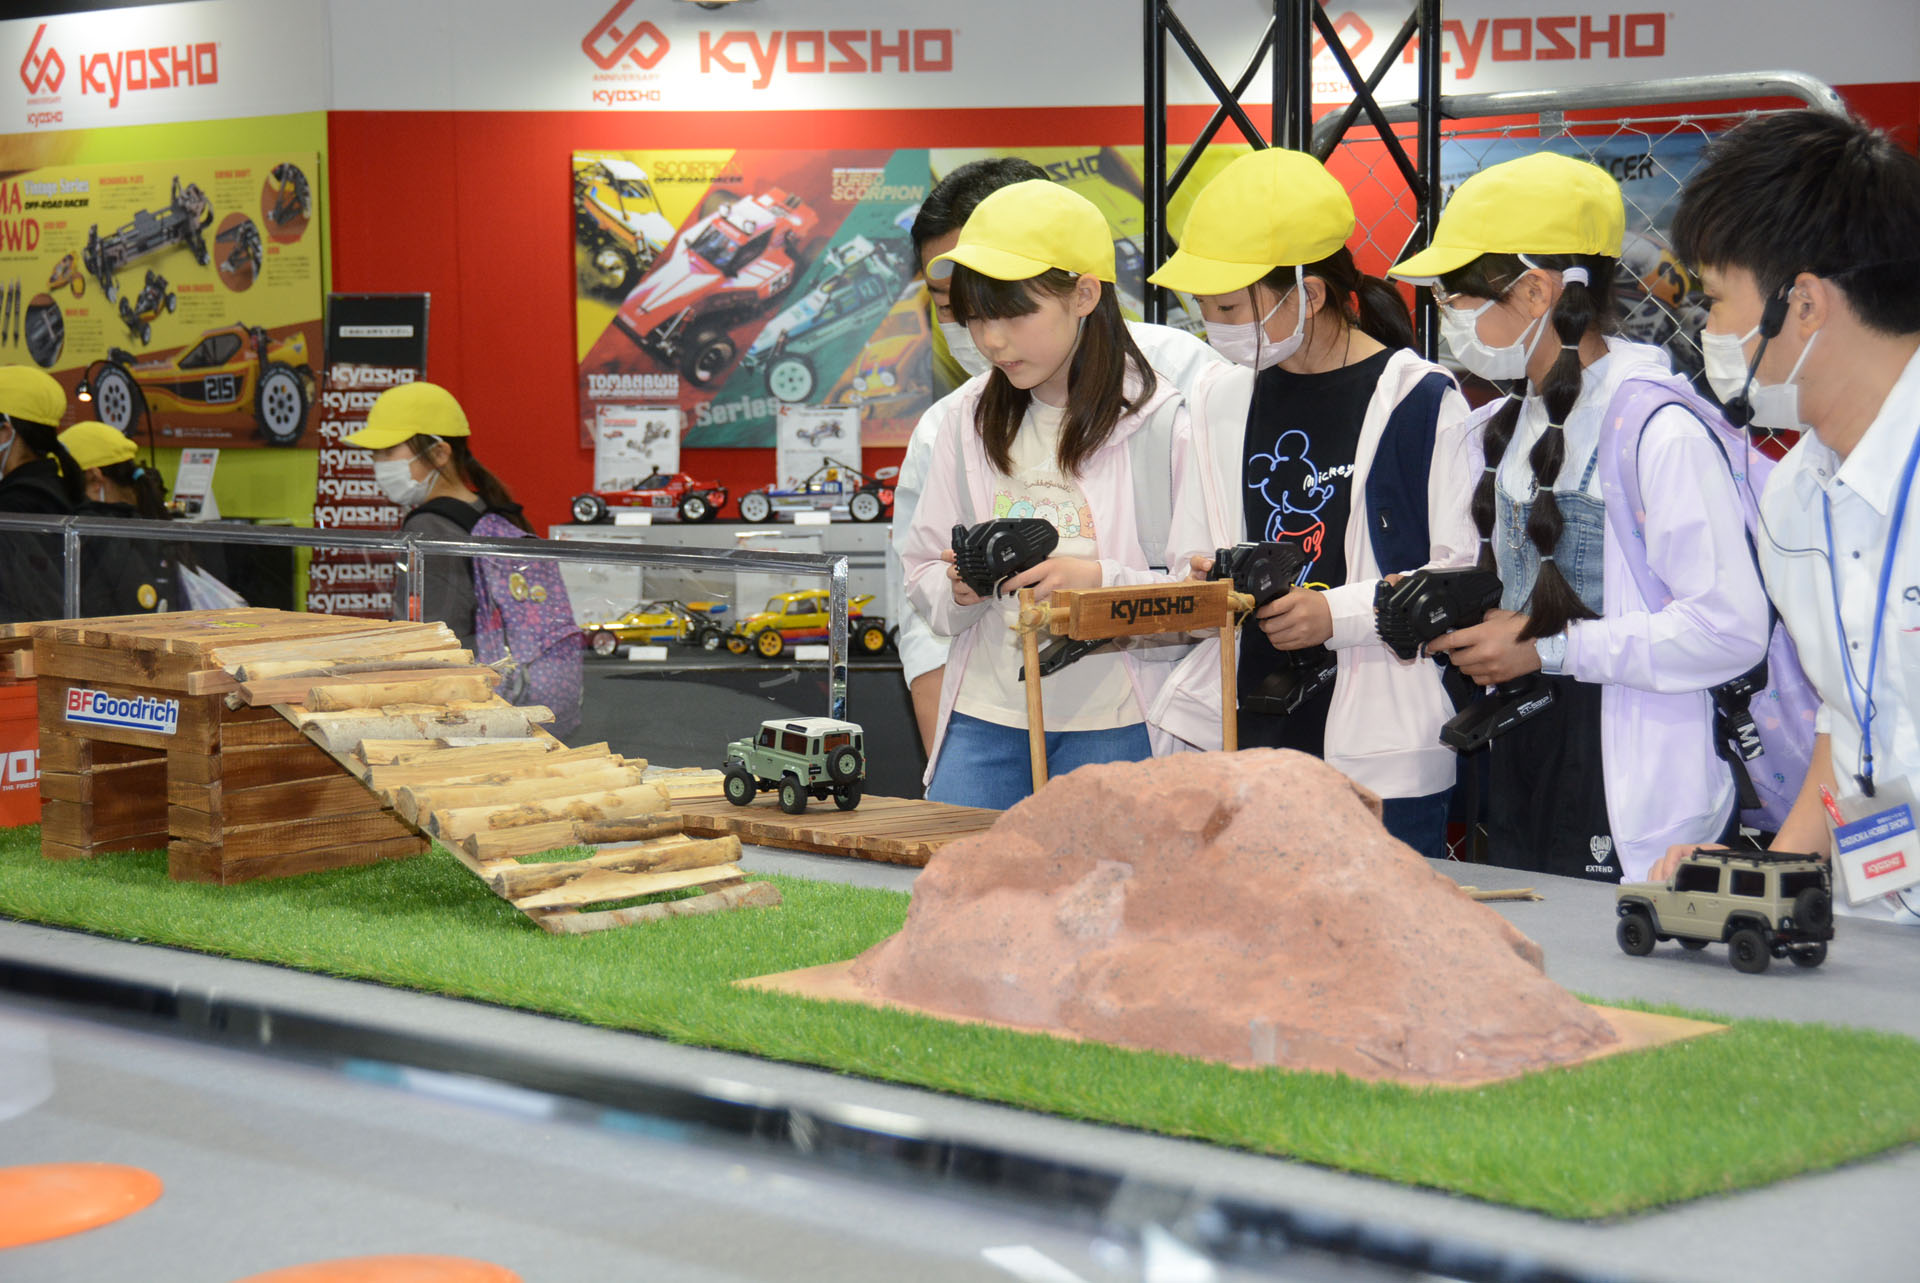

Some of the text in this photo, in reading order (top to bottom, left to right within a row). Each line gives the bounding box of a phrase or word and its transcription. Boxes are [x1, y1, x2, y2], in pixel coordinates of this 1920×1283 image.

[700, 30, 953, 89] KYOSHO
[80, 42, 219, 108] KYOSHO
[592, 90, 661, 106] KYOSHO
[832, 173, 885, 187] TURBO
[831, 186, 925, 201] SCORPION
[206, 377, 234, 400] 215
[588, 374, 679, 391] TOMAHAWK
[1303, 464, 1354, 491] Mickey
[311, 564, 394, 585] KYOSHO
[307, 593, 392, 614] KYOSHO
[1111, 596, 1194, 625] KYOSHO
[68, 690, 178, 723] BFGoodrich
[1585, 864, 1613, 873] EXTEND
